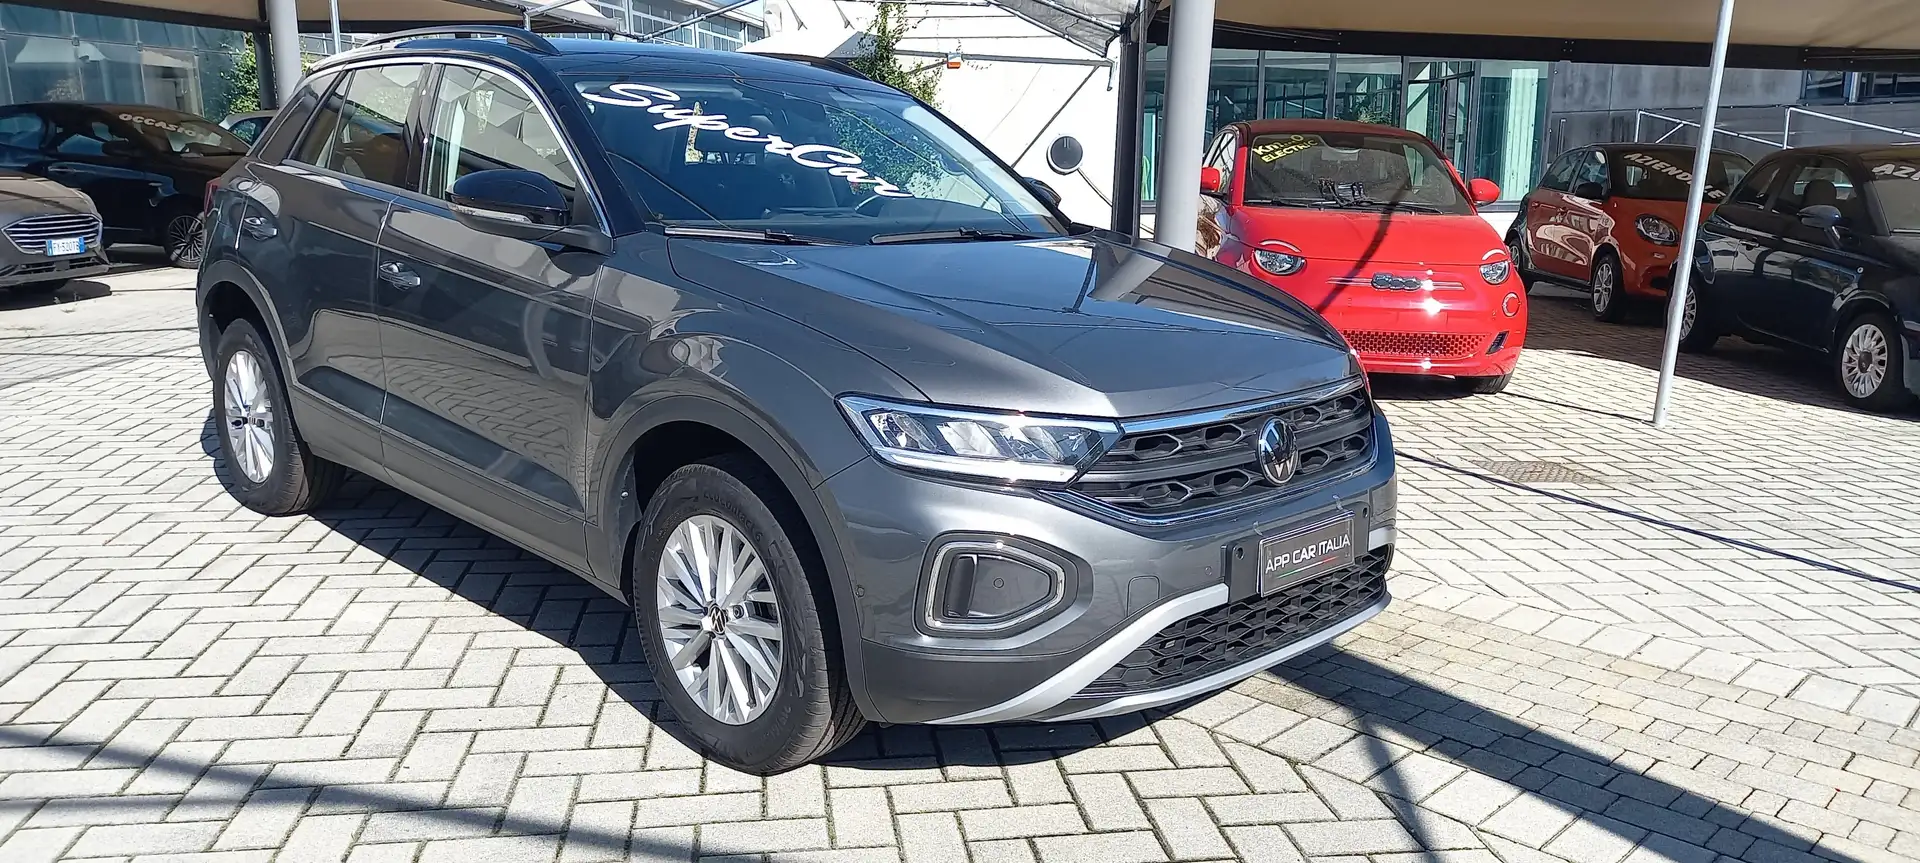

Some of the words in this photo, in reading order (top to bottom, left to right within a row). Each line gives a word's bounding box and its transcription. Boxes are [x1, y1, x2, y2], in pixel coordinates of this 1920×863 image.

[118, 113, 205, 142] OCCASIO
[580, 82, 913, 197] SuperCar
[1261, 140, 1318, 163] ELECTRIC
[1624, 152, 1727, 199] AZIENDLE
[1265, 553, 1290, 574] APP
[1293, 544, 1316, 564] CAR
[1318, 534, 1351, 556] ITALIA
